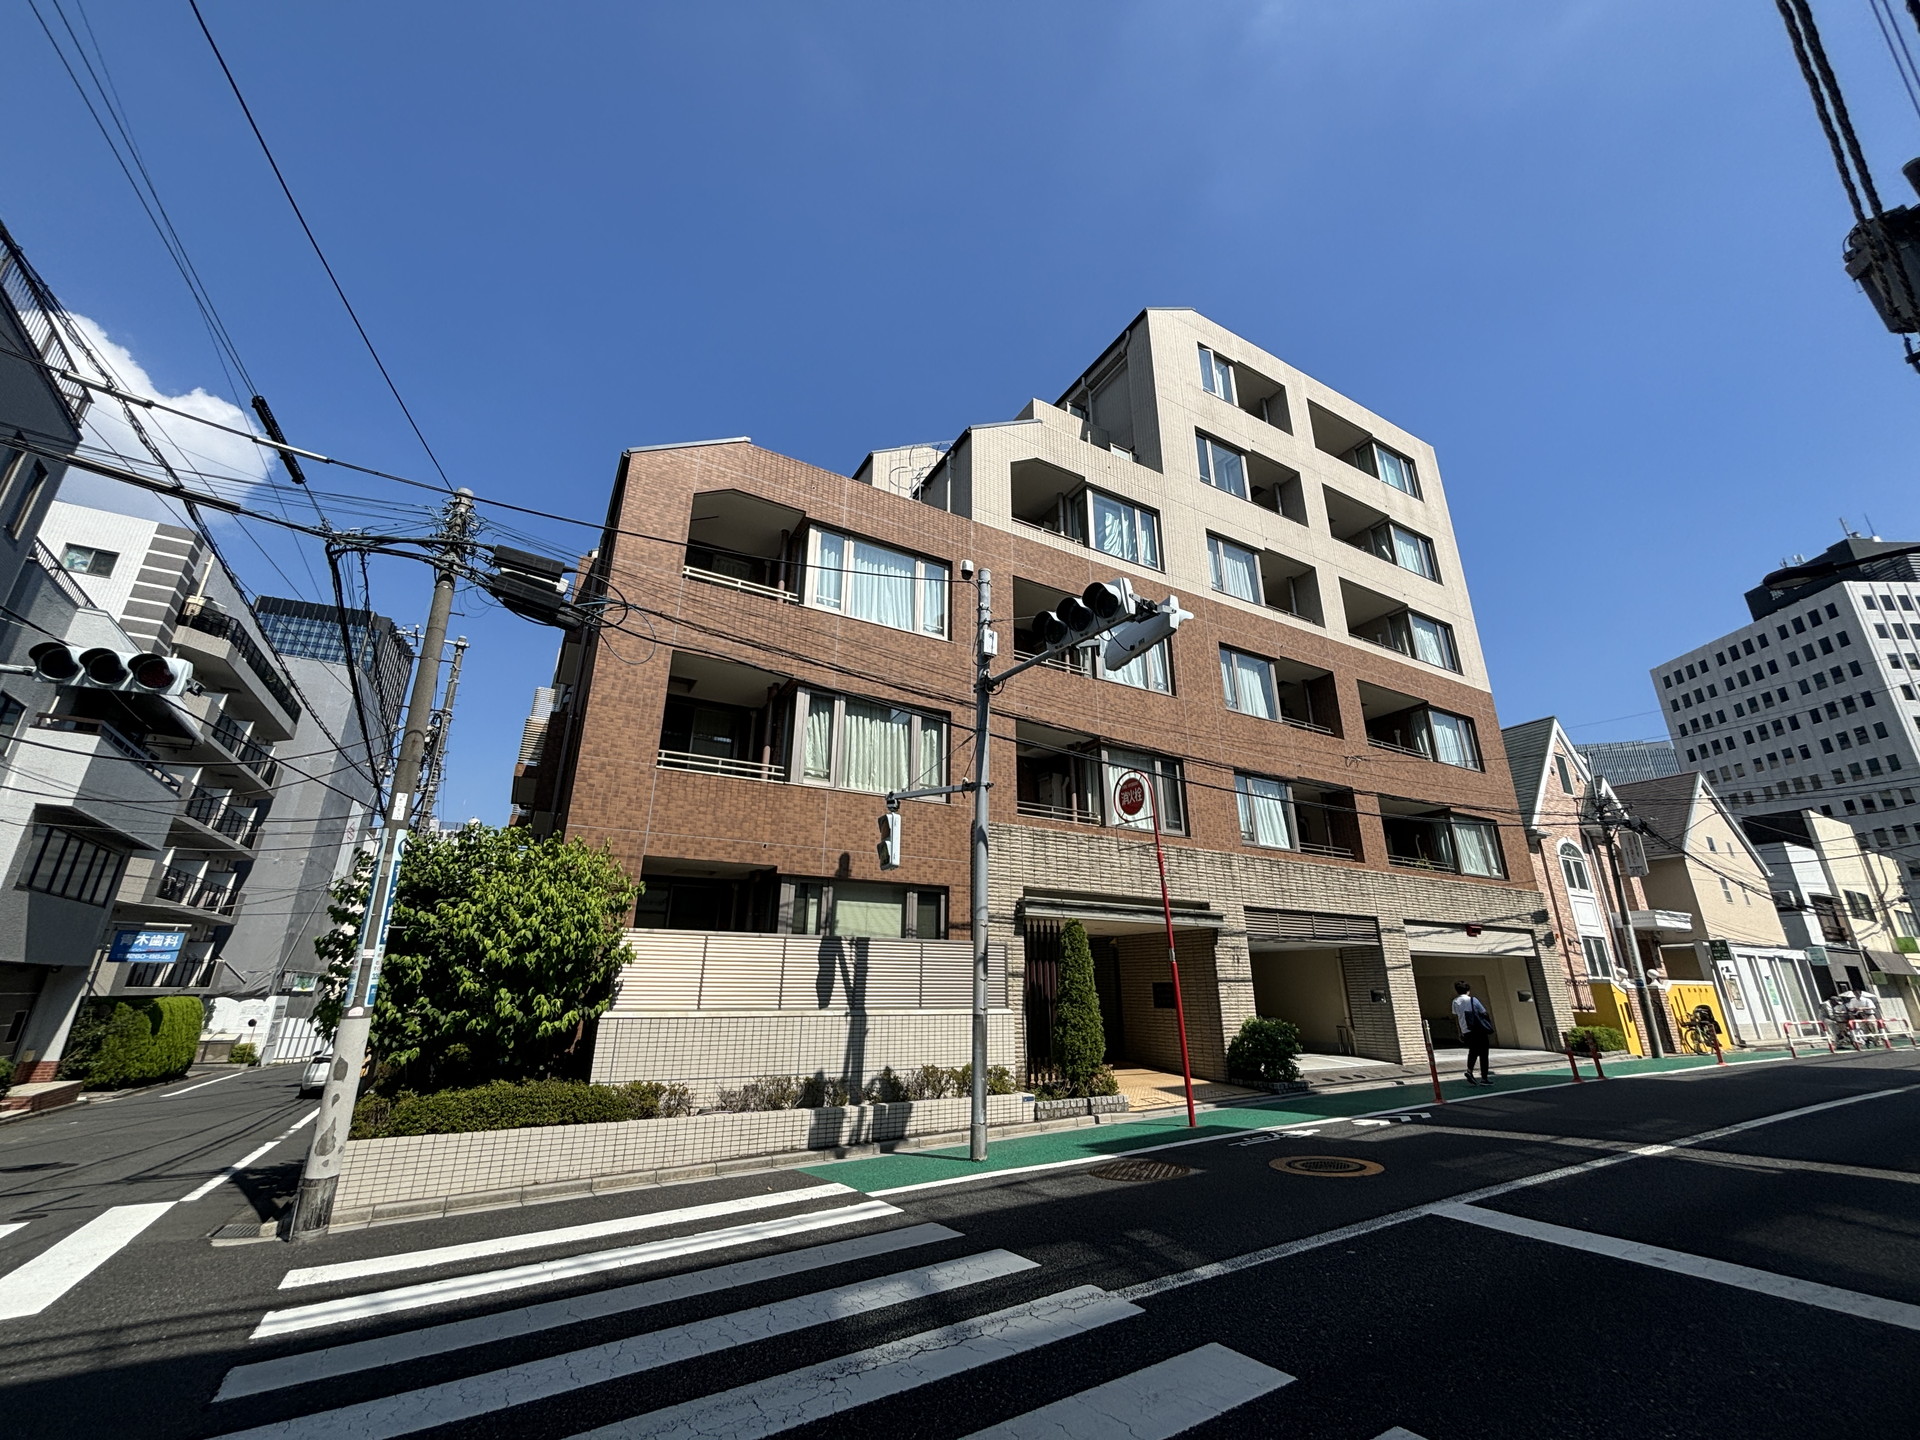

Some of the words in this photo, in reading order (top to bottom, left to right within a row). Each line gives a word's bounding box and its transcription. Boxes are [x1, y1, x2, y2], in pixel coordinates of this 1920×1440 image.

[1121, 787, 1143, 807] 消火栓
[120, 933, 179, 947] 青木歯科
